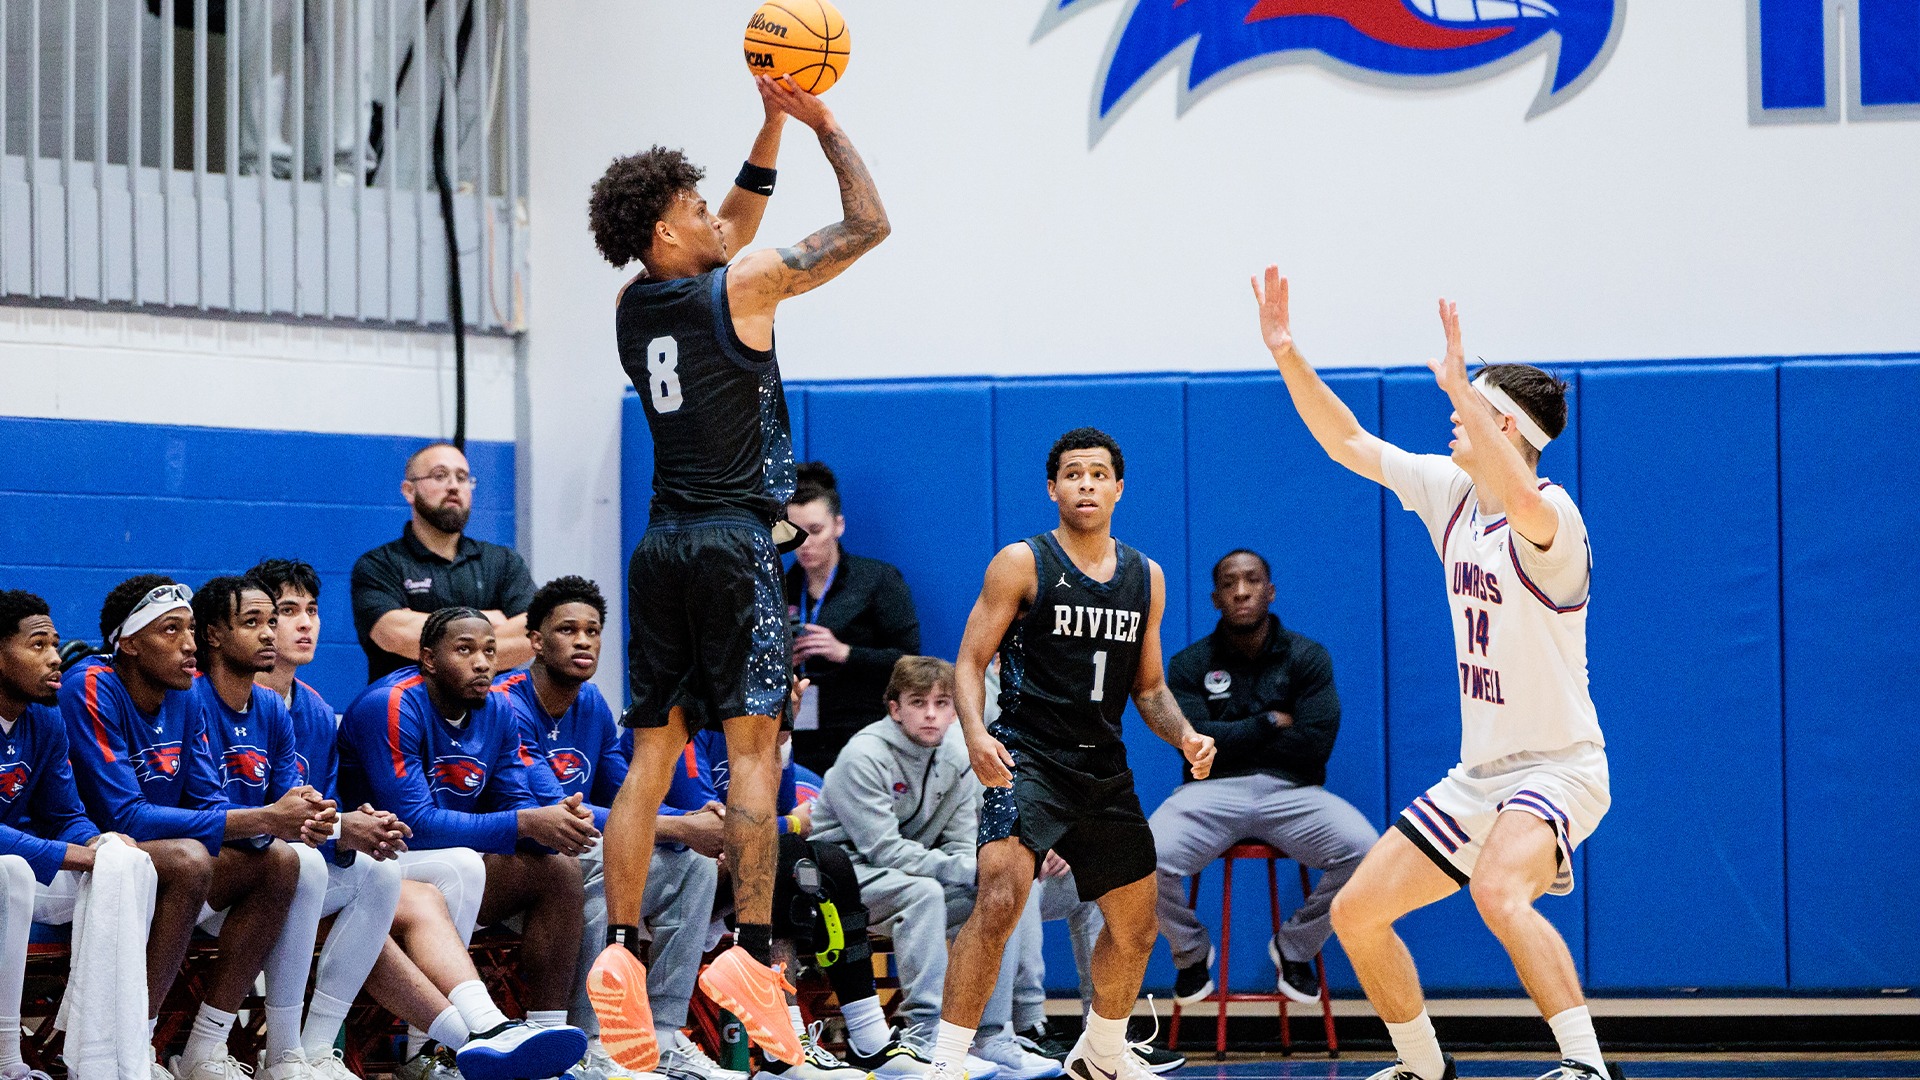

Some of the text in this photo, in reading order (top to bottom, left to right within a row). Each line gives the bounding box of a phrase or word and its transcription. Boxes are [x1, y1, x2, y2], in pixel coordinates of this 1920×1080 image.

[647, 335, 684, 414] 8
[1453, 561, 1503, 605] UMASS
[1052, 604, 1142, 643] RIVIER
[1464, 606, 1490, 658] 14
[1090, 650, 1108, 702] 1
[722, 1022, 741, 1044] G
